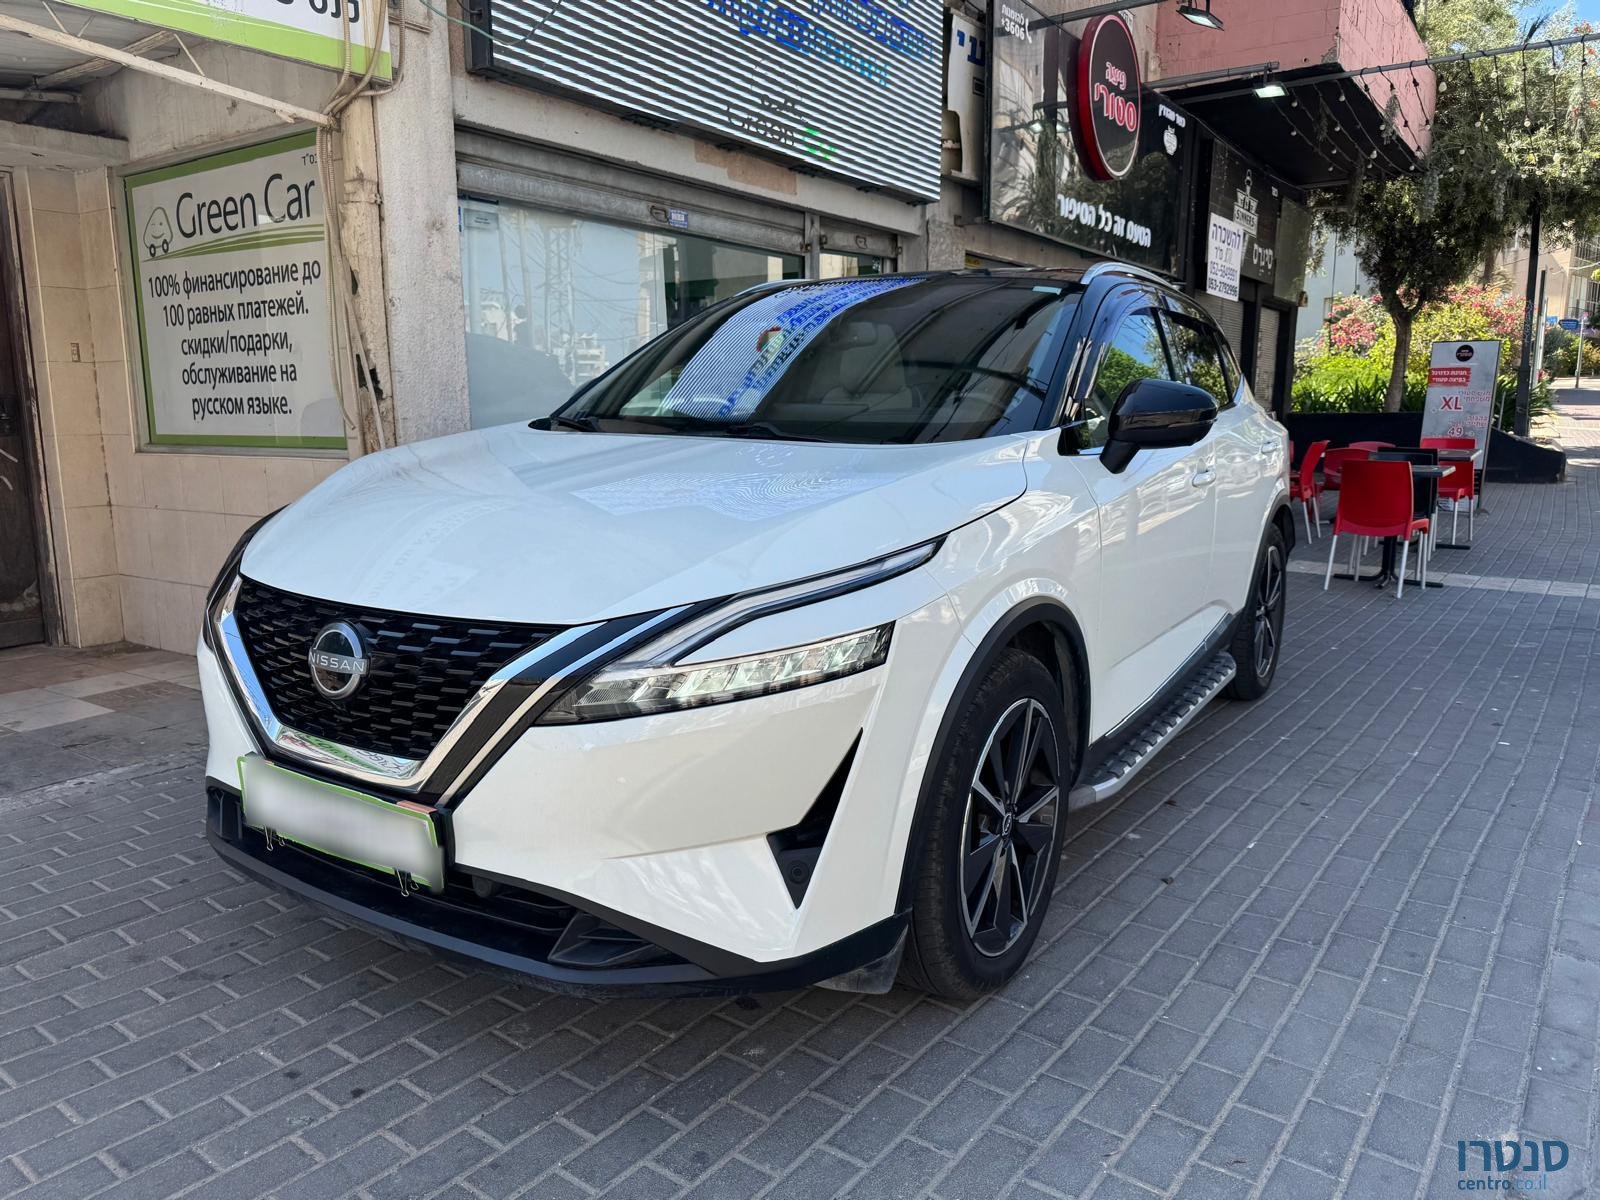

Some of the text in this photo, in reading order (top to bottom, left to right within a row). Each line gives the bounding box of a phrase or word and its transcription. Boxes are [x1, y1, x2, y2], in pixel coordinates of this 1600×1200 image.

[1105, 61, 1127, 91] פיצה
[1094, 82, 1137, 132] סטורי
[176, 173, 316, 239] Green Car
[1057, 193, 1097, 228] הסיפור
[1098, 203, 1113, 233] כל
[1211, 222, 1241, 250] להשכרה
[149, 260, 321, 299] 100% финансирование до
[163, 290, 309, 330] 100 равных платежей.
[181, 330, 293, 359] скидки/подарки,
[182, 362, 297, 390] обслуживание на
[192, 395, 292, 420] русском языке.
[1441, 396, 1462, 411] XL
[1449, 427, 1462, 436] 49
[308, 651, 365, 672] NISSAN
